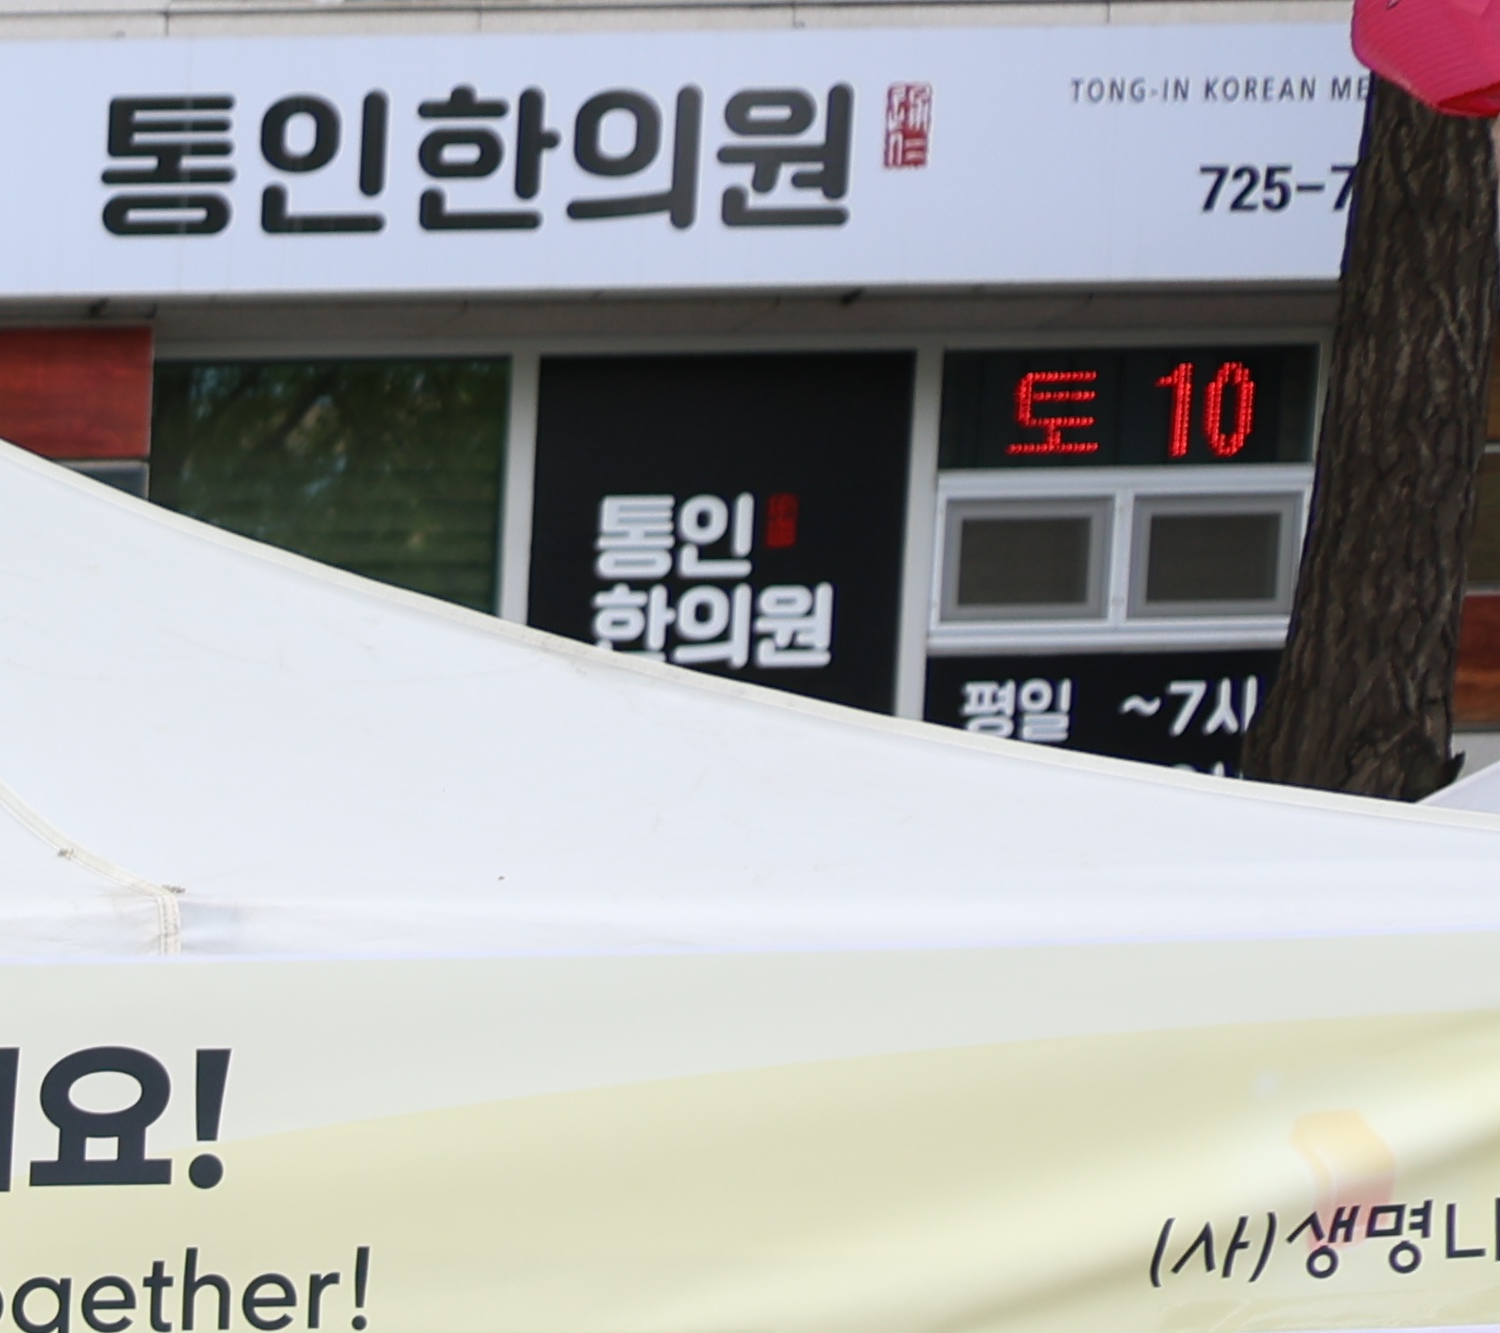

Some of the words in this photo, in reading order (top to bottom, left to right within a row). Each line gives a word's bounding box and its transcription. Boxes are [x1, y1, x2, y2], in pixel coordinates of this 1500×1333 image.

[1072, 77, 1190, 104] TONG-IN
[1205, 75, 1317, 101] KOREAN
[101, 84, 854, 236] 통인한의원
[1006, 370, 1100, 456] 토
[1155, 361, 1256, 458] 10
[596, 491, 755, 579] 통인
[593, 581, 835, 669] 한의원
[960, 677, 1073, 742] 평일
